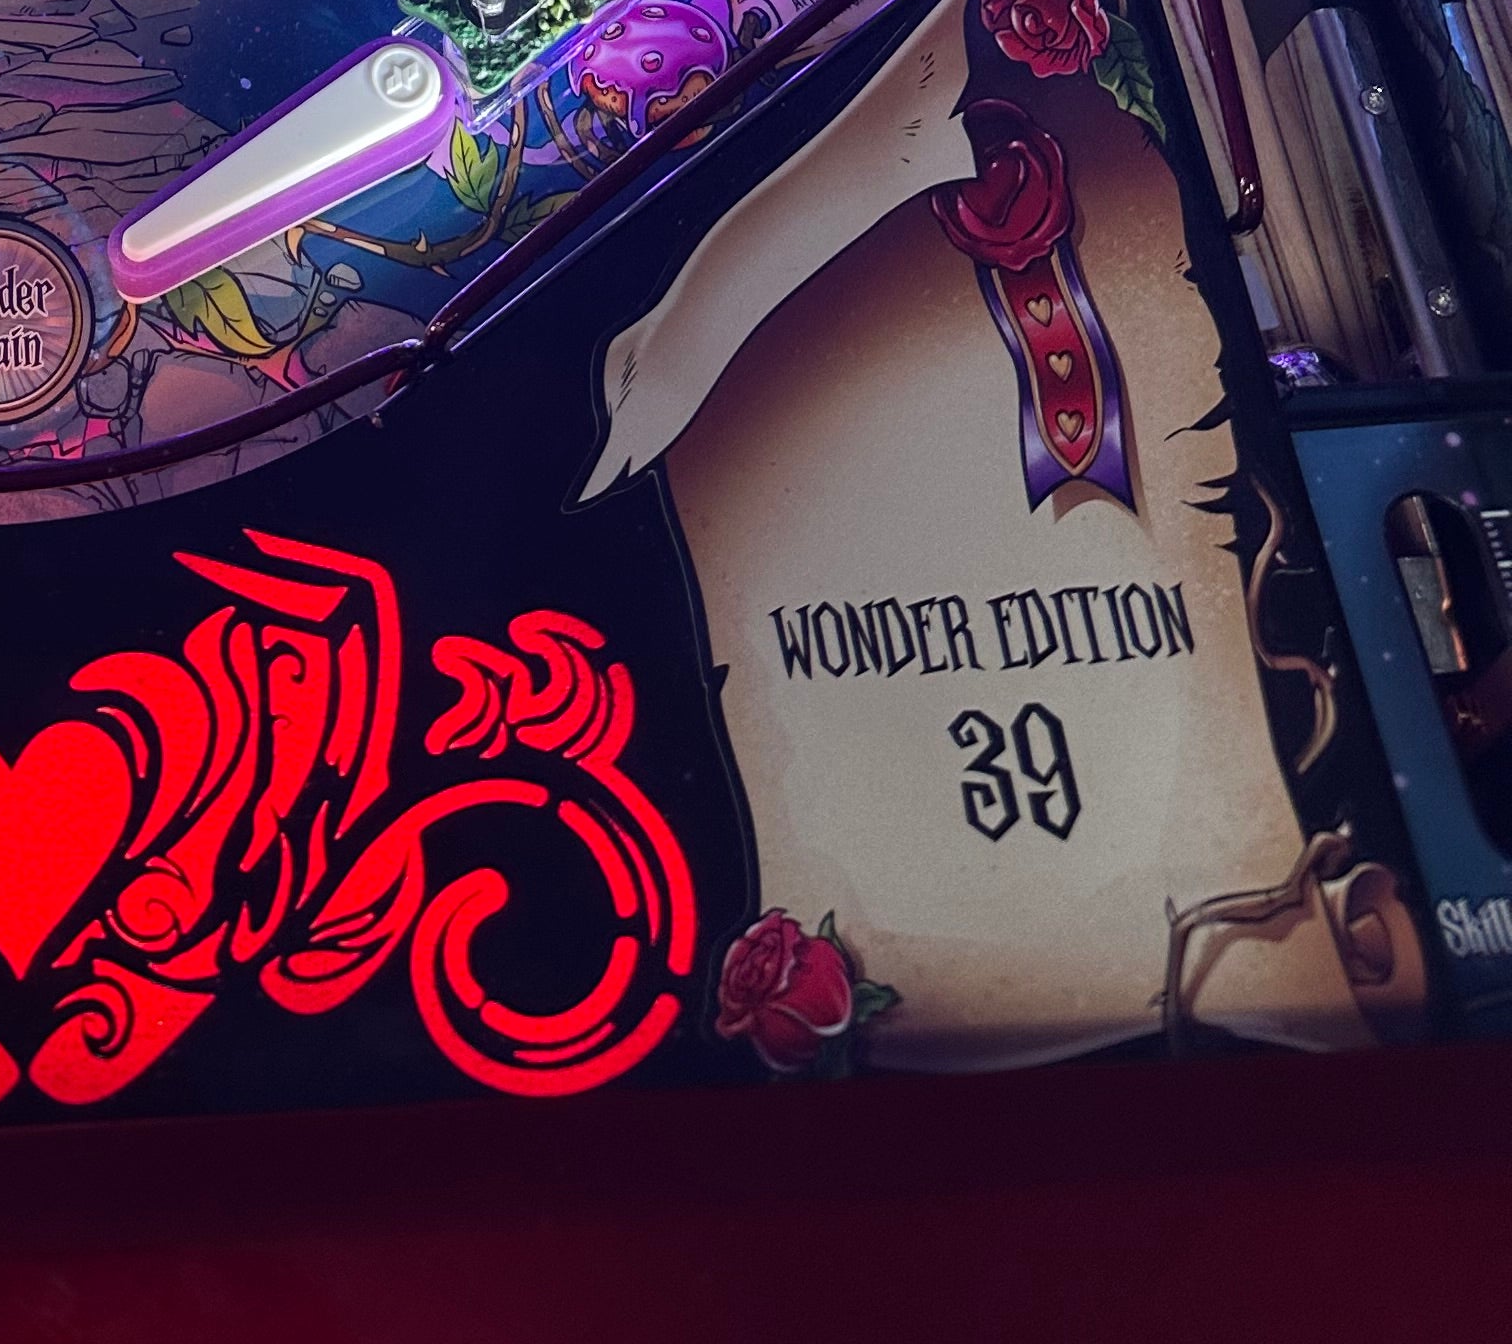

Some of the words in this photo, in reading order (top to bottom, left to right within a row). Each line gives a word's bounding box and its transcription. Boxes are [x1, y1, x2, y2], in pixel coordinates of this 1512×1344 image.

[768, 595, 984, 681] WONDER
[988, 581, 1196, 672] EDITION
[947, 701, 1083, 843] 39
